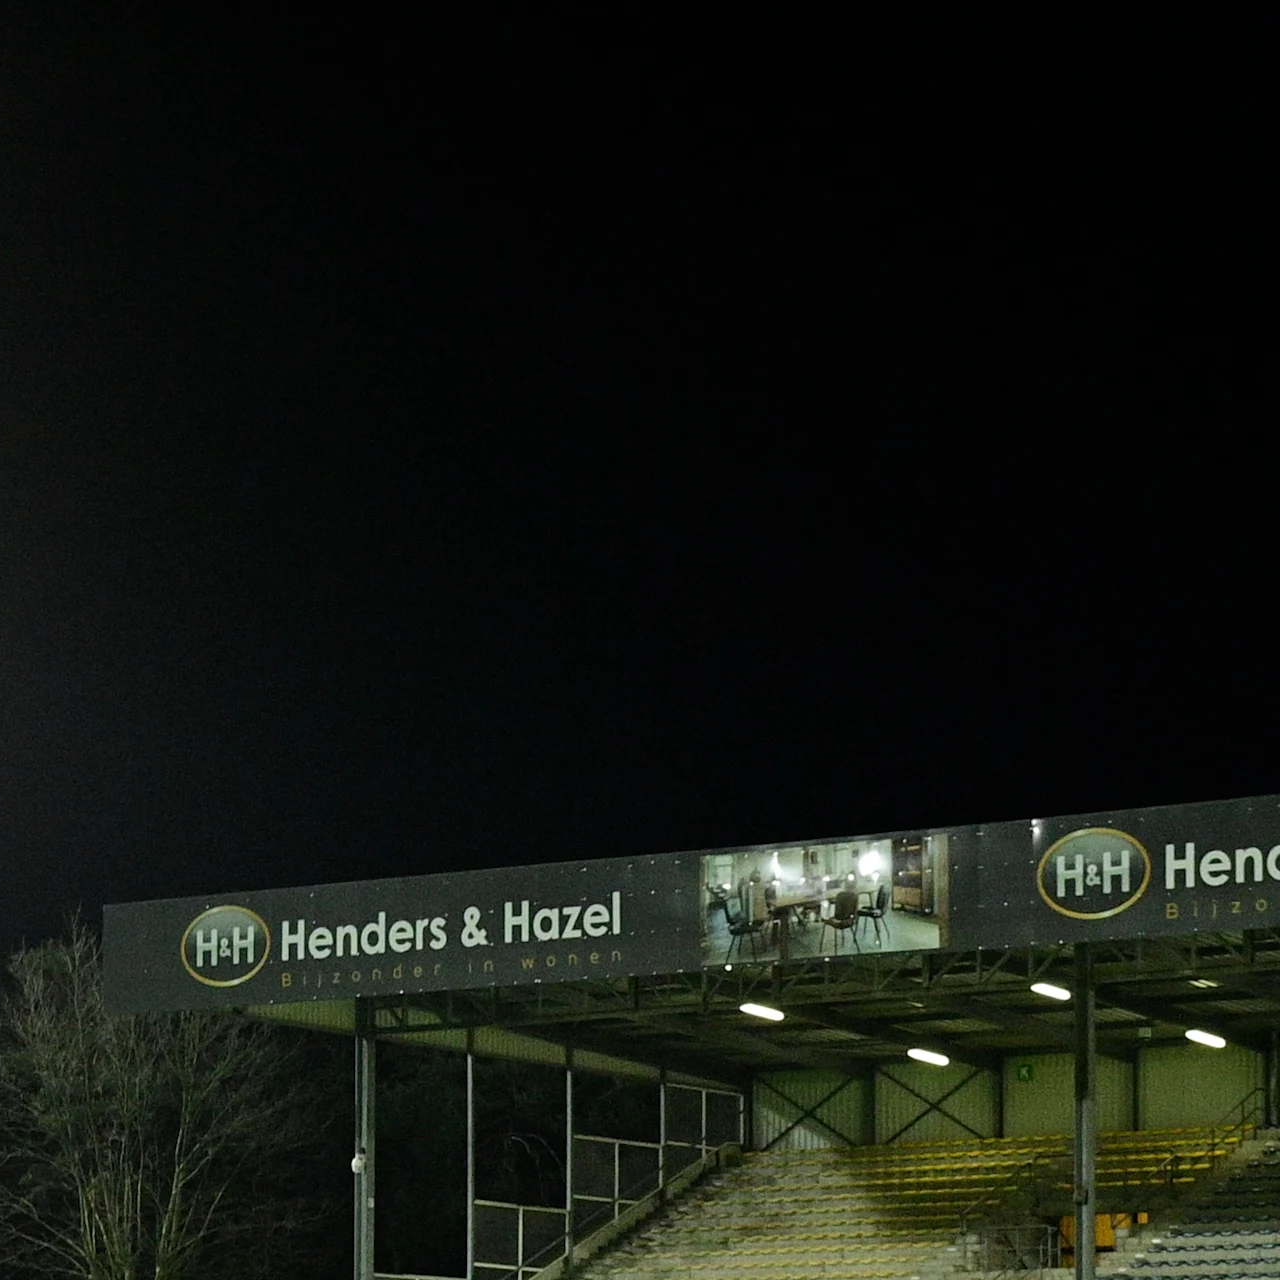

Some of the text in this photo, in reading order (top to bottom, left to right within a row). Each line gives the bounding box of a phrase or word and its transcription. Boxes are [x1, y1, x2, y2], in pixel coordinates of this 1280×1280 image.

[1055, 848, 1131, 898] H&H
[195, 925, 255, 967] H&H
[281, 891, 622, 961] Henders & Hazel
[281, 950, 623, 989] Bijzonder in wonen
